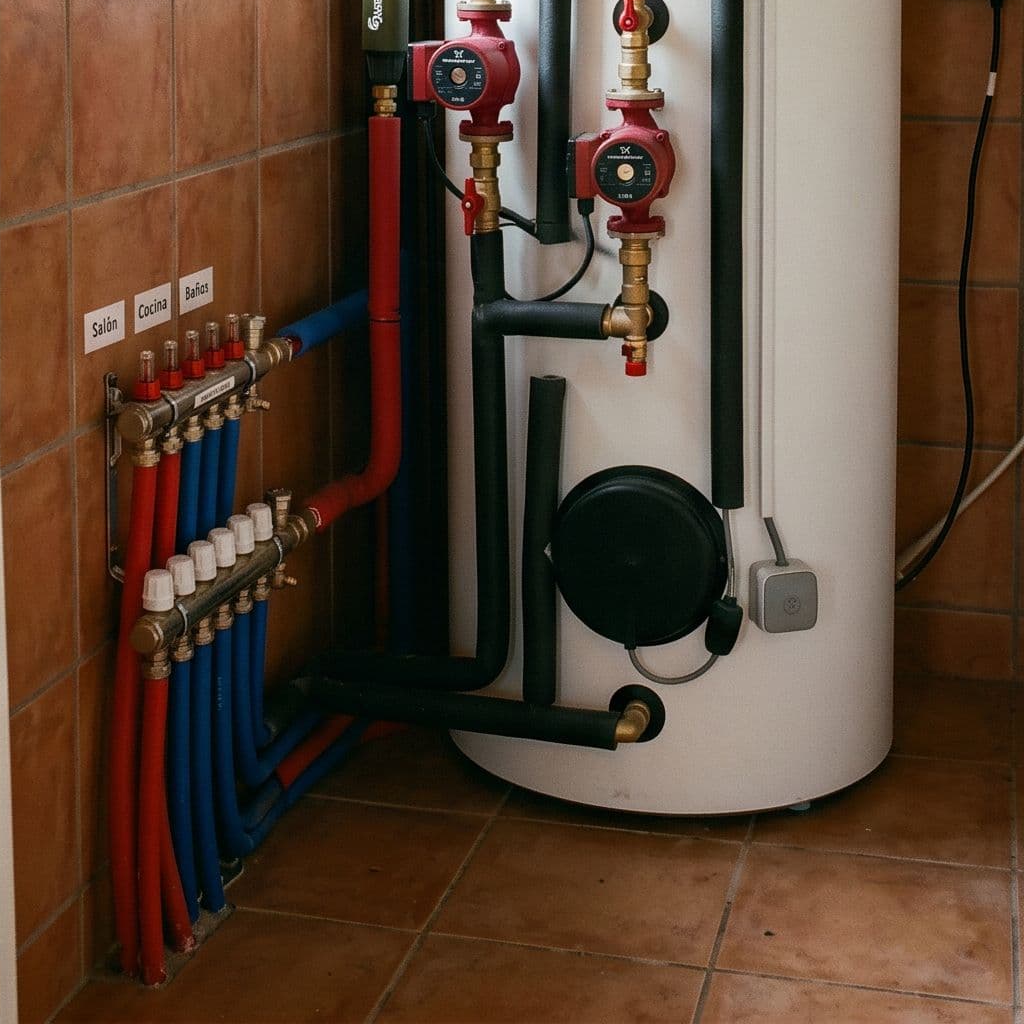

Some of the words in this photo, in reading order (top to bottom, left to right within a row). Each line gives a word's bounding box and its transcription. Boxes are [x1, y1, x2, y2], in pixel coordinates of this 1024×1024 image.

[185, 282, 209, 301] Baños
[138, 298, 168, 319] Cocina
[92, 316, 118, 337] Salón
